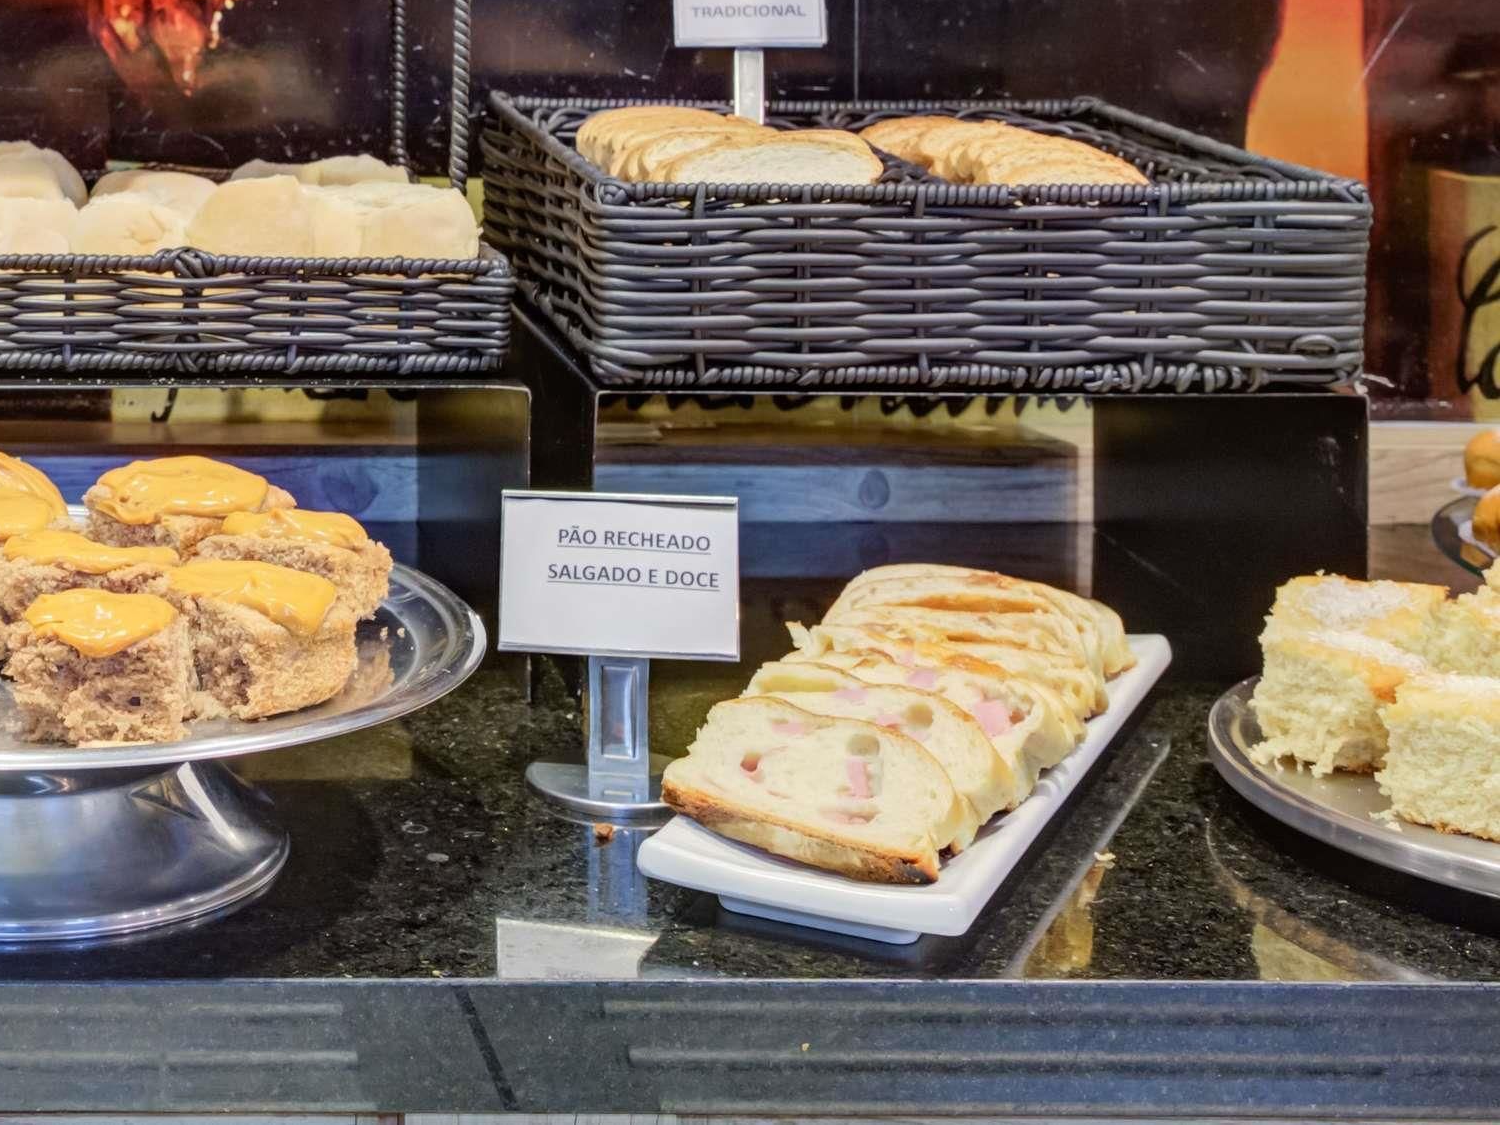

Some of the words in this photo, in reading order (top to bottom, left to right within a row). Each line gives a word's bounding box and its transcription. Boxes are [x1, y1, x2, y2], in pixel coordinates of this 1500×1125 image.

[692, 5, 806, 18] TRADICIONAL
[558, 525, 597, 545] PÃO
[604, 530, 711, 551] RECHEADO
[548, 563, 641, 584] SALGADO
[649, 569, 658, 583] E
[666, 570, 720, 587] DOCE
